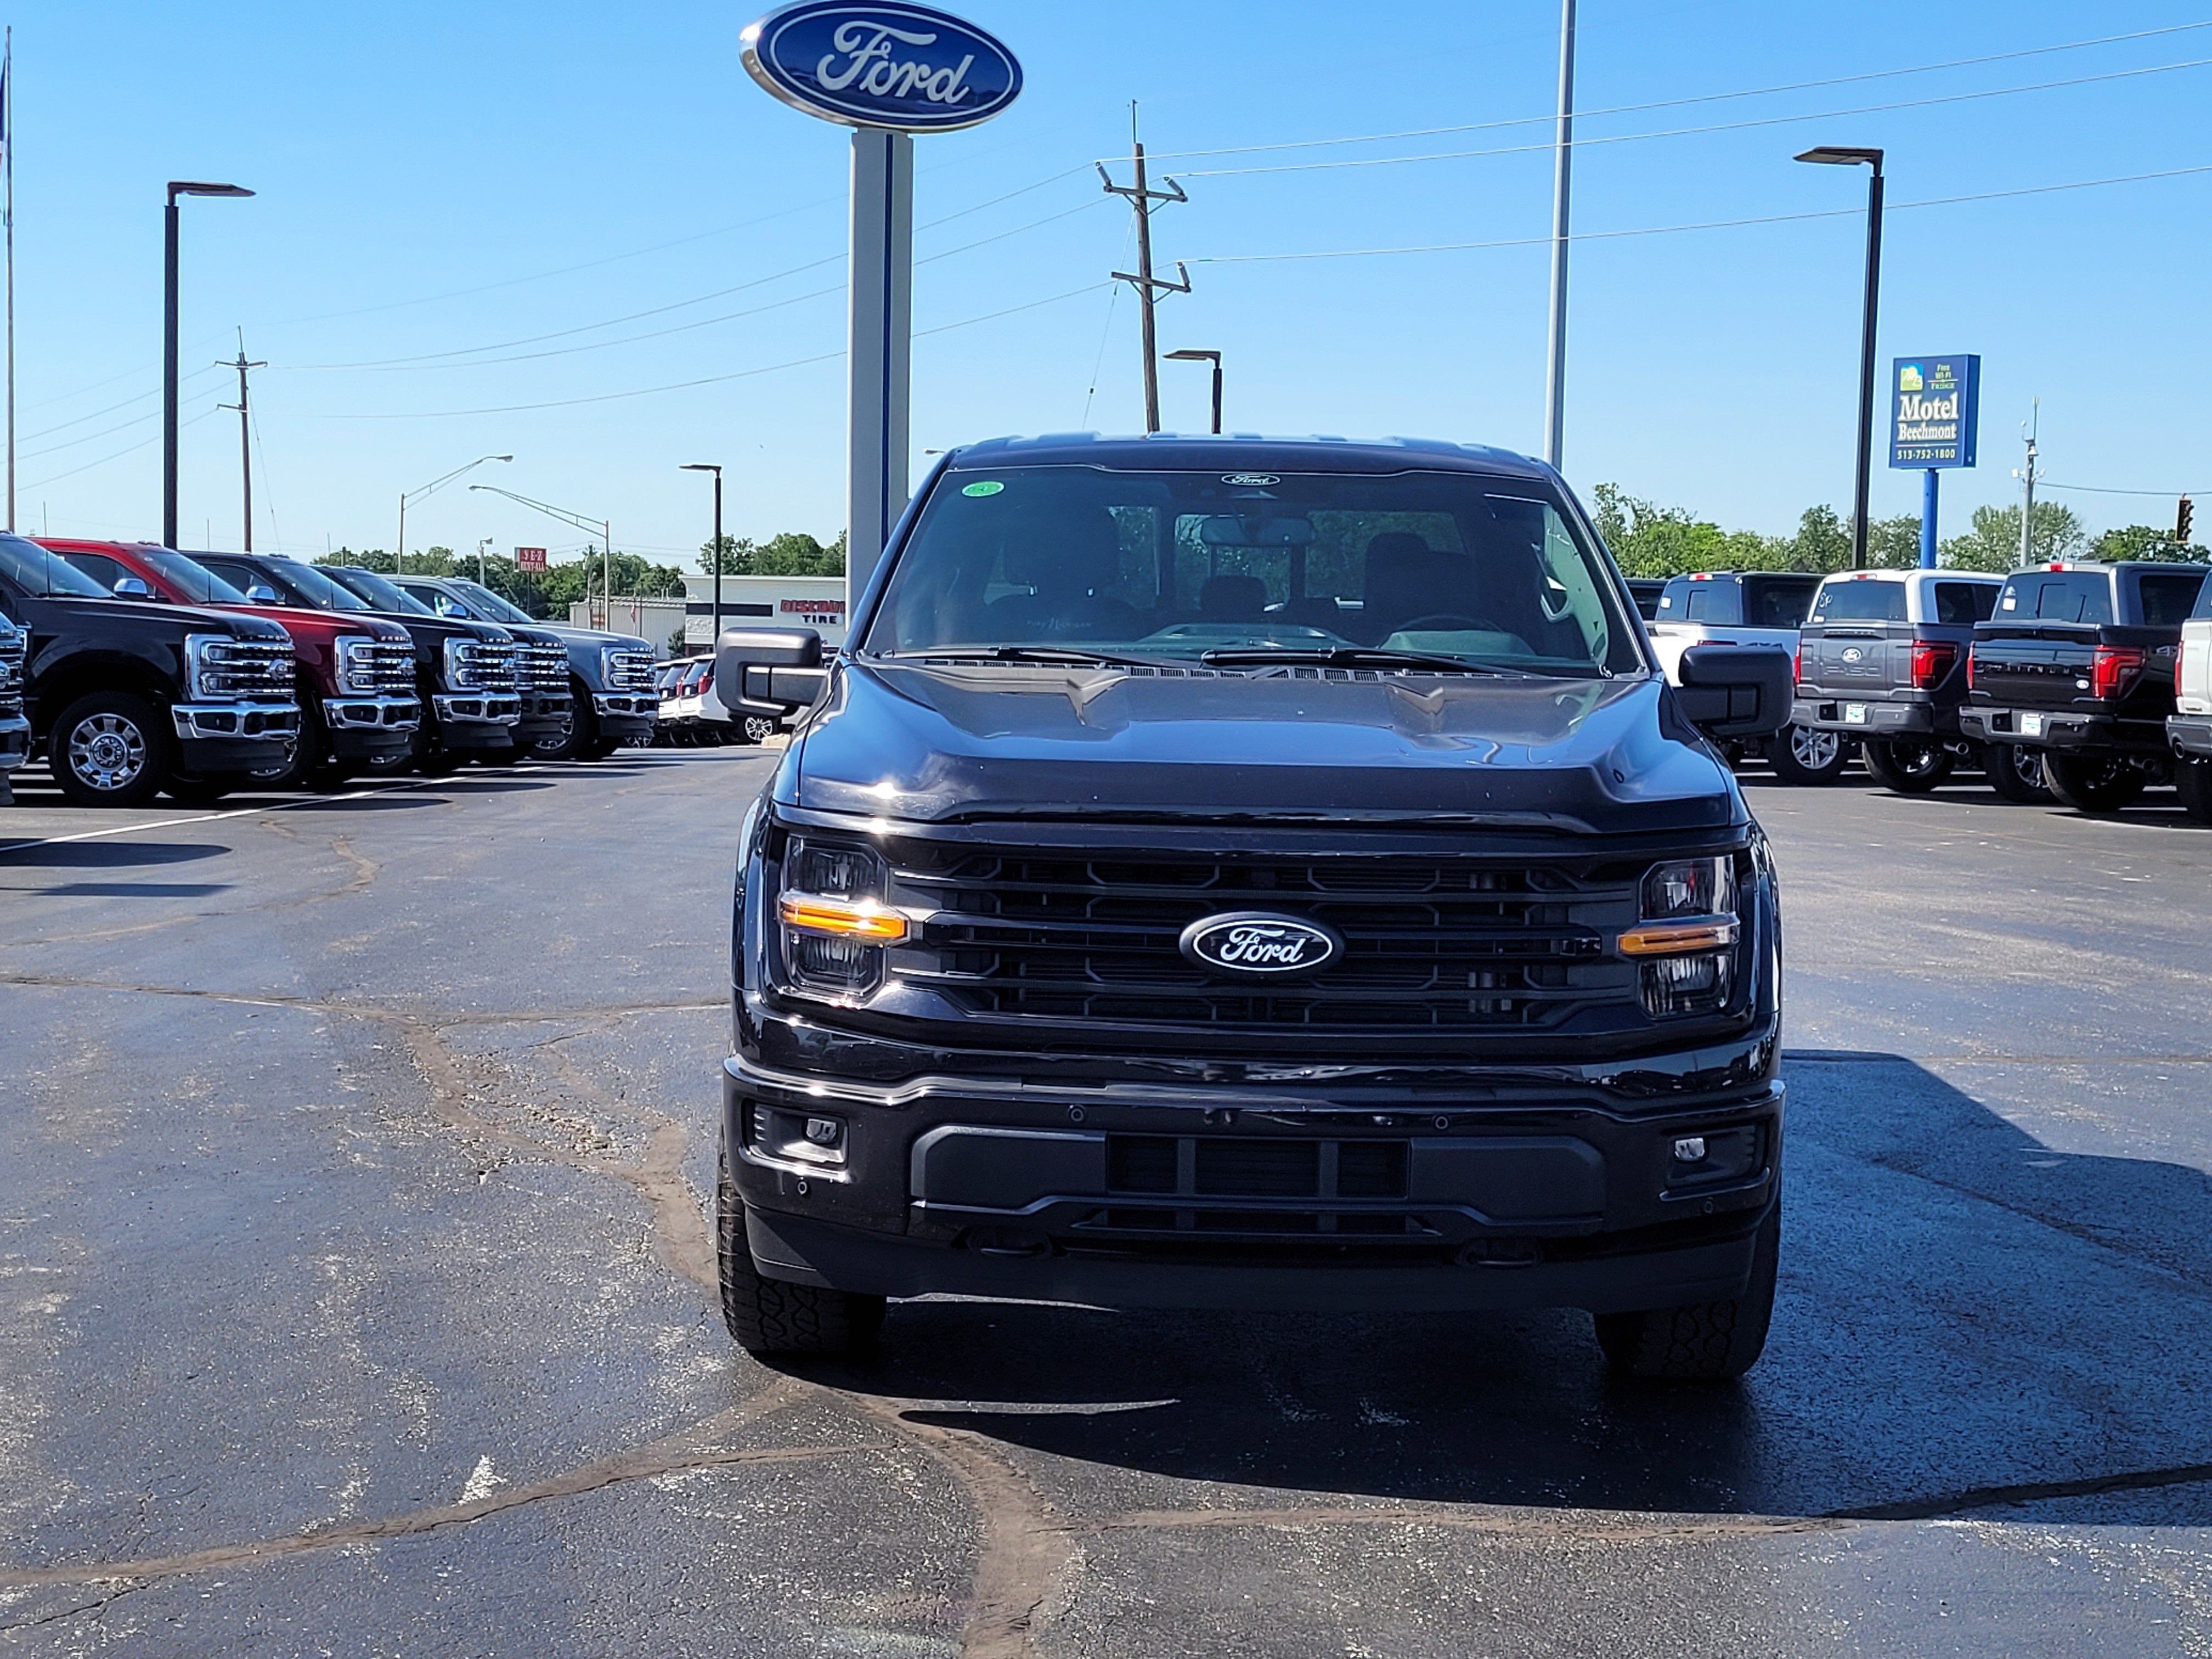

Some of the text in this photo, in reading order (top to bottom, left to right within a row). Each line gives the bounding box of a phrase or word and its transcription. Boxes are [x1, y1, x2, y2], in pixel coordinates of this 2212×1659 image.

[816, 21, 974, 104] Ford
[1897, 391, 1959, 421] Motel
[1897, 421, 1957, 441] Beechmont
[802, 614, 837, 624] TIRE
[1220, 927, 1306, 963] Ford
